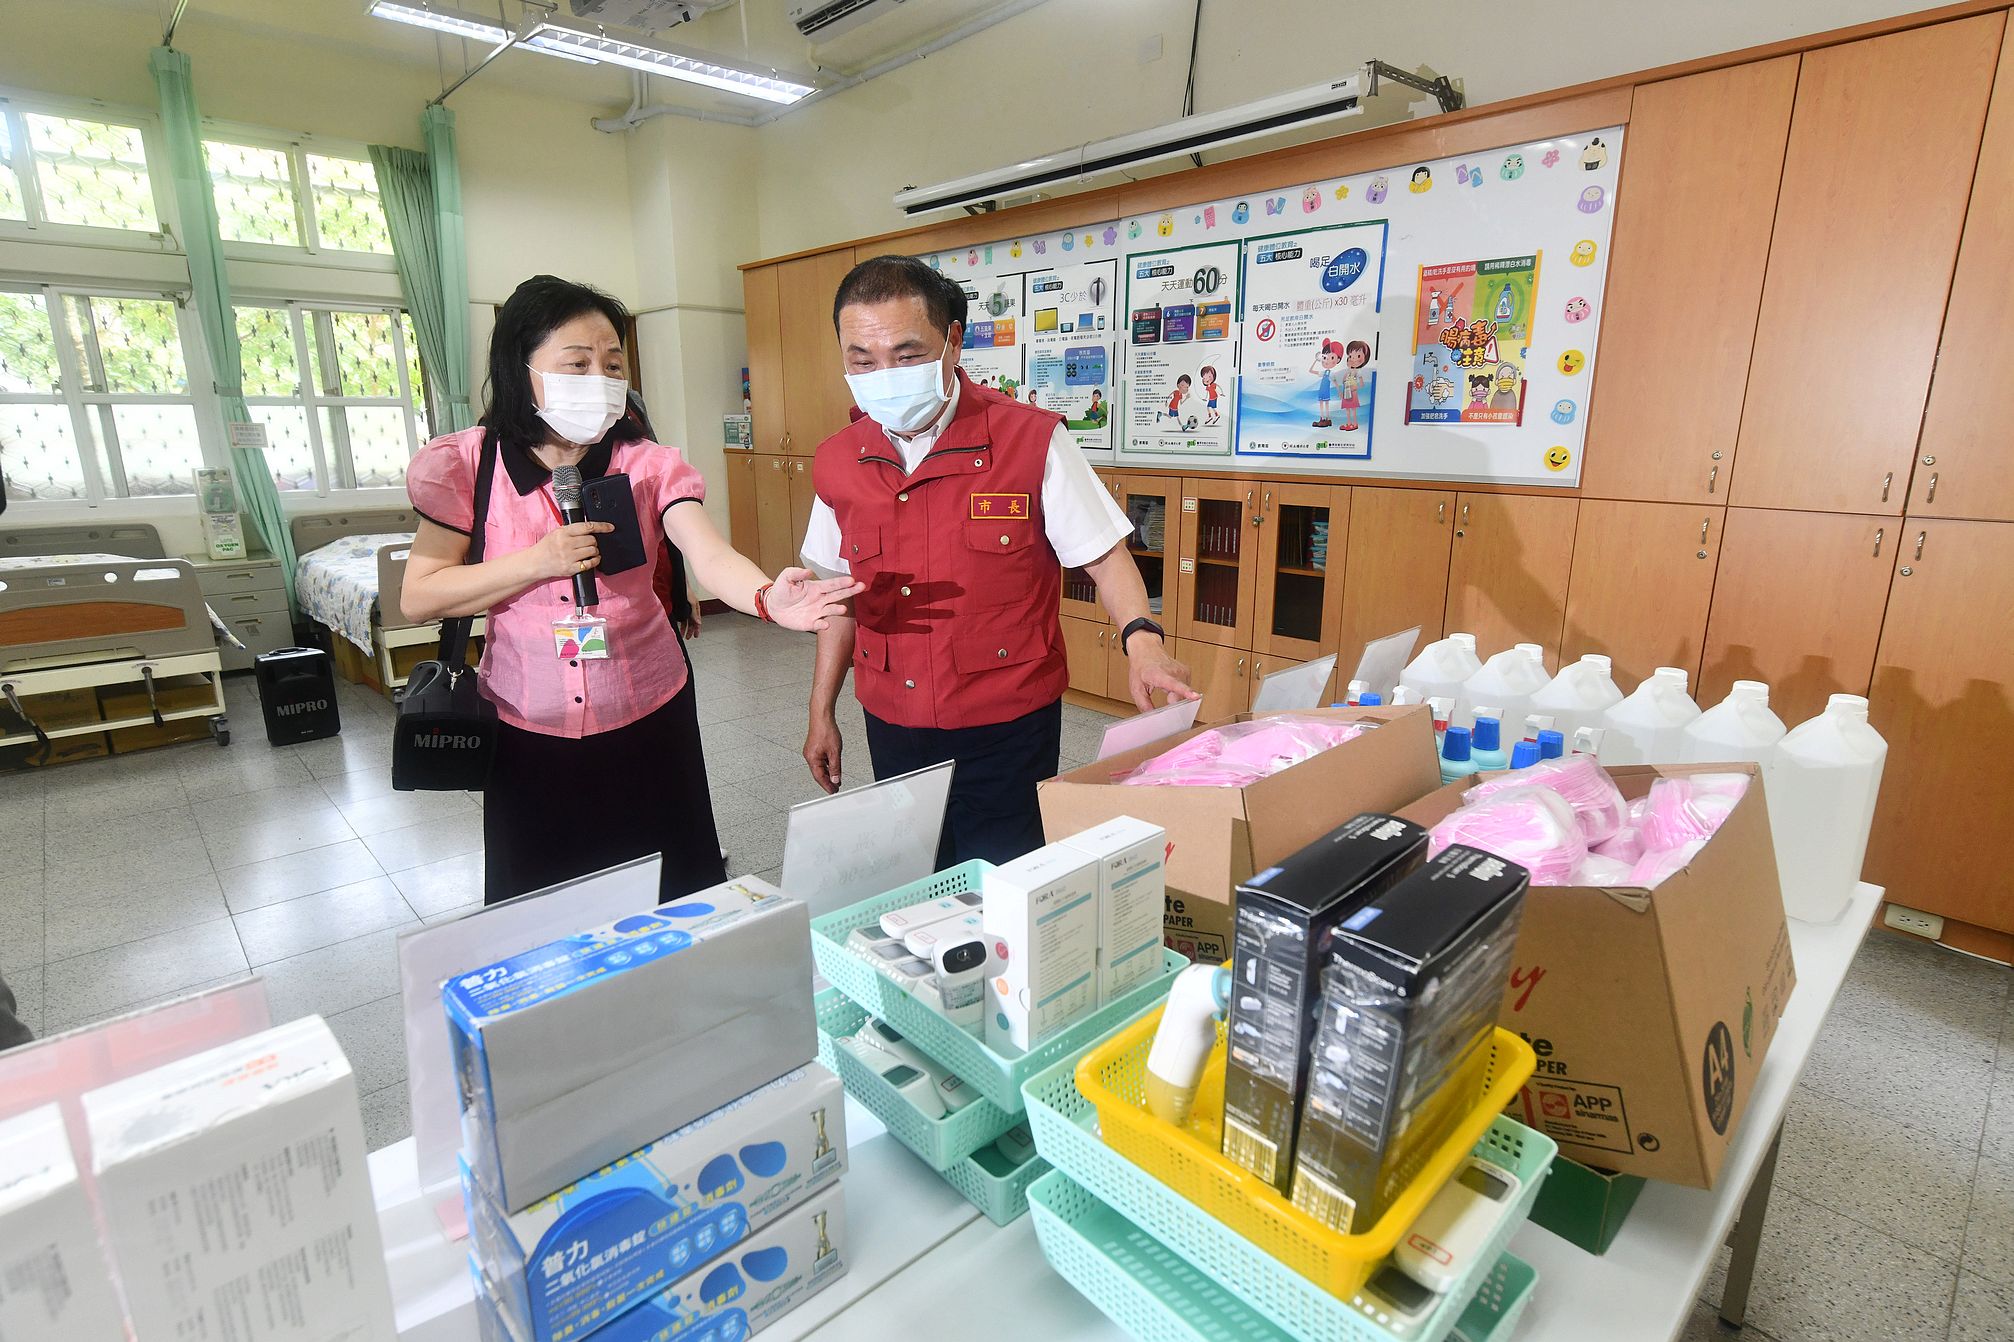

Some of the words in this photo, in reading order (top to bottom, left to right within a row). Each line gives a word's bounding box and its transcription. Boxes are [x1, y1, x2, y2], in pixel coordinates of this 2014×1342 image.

[1309, 256, 1330, 268] 喝足
[1328, 262, 1360, 277] 白開水
[1253, 301, 1290, 313] 每天喝白開水
[1296, 297, 1333, 312] 體重(公斤)
[1440, 320, 1488, 350] 腸病毒
[1457, 348, 1486, 366] 注意
[978, 499, 1021, 514] 市長
[276, 699, 328, 717] MIPRO
[1163, 914, 1194, 928] PAPER
[1197, 941, 1220, 955] APP
[1573, 1093, 1612, 1112] APP
[541, 1239, 589, 1279] 普力
